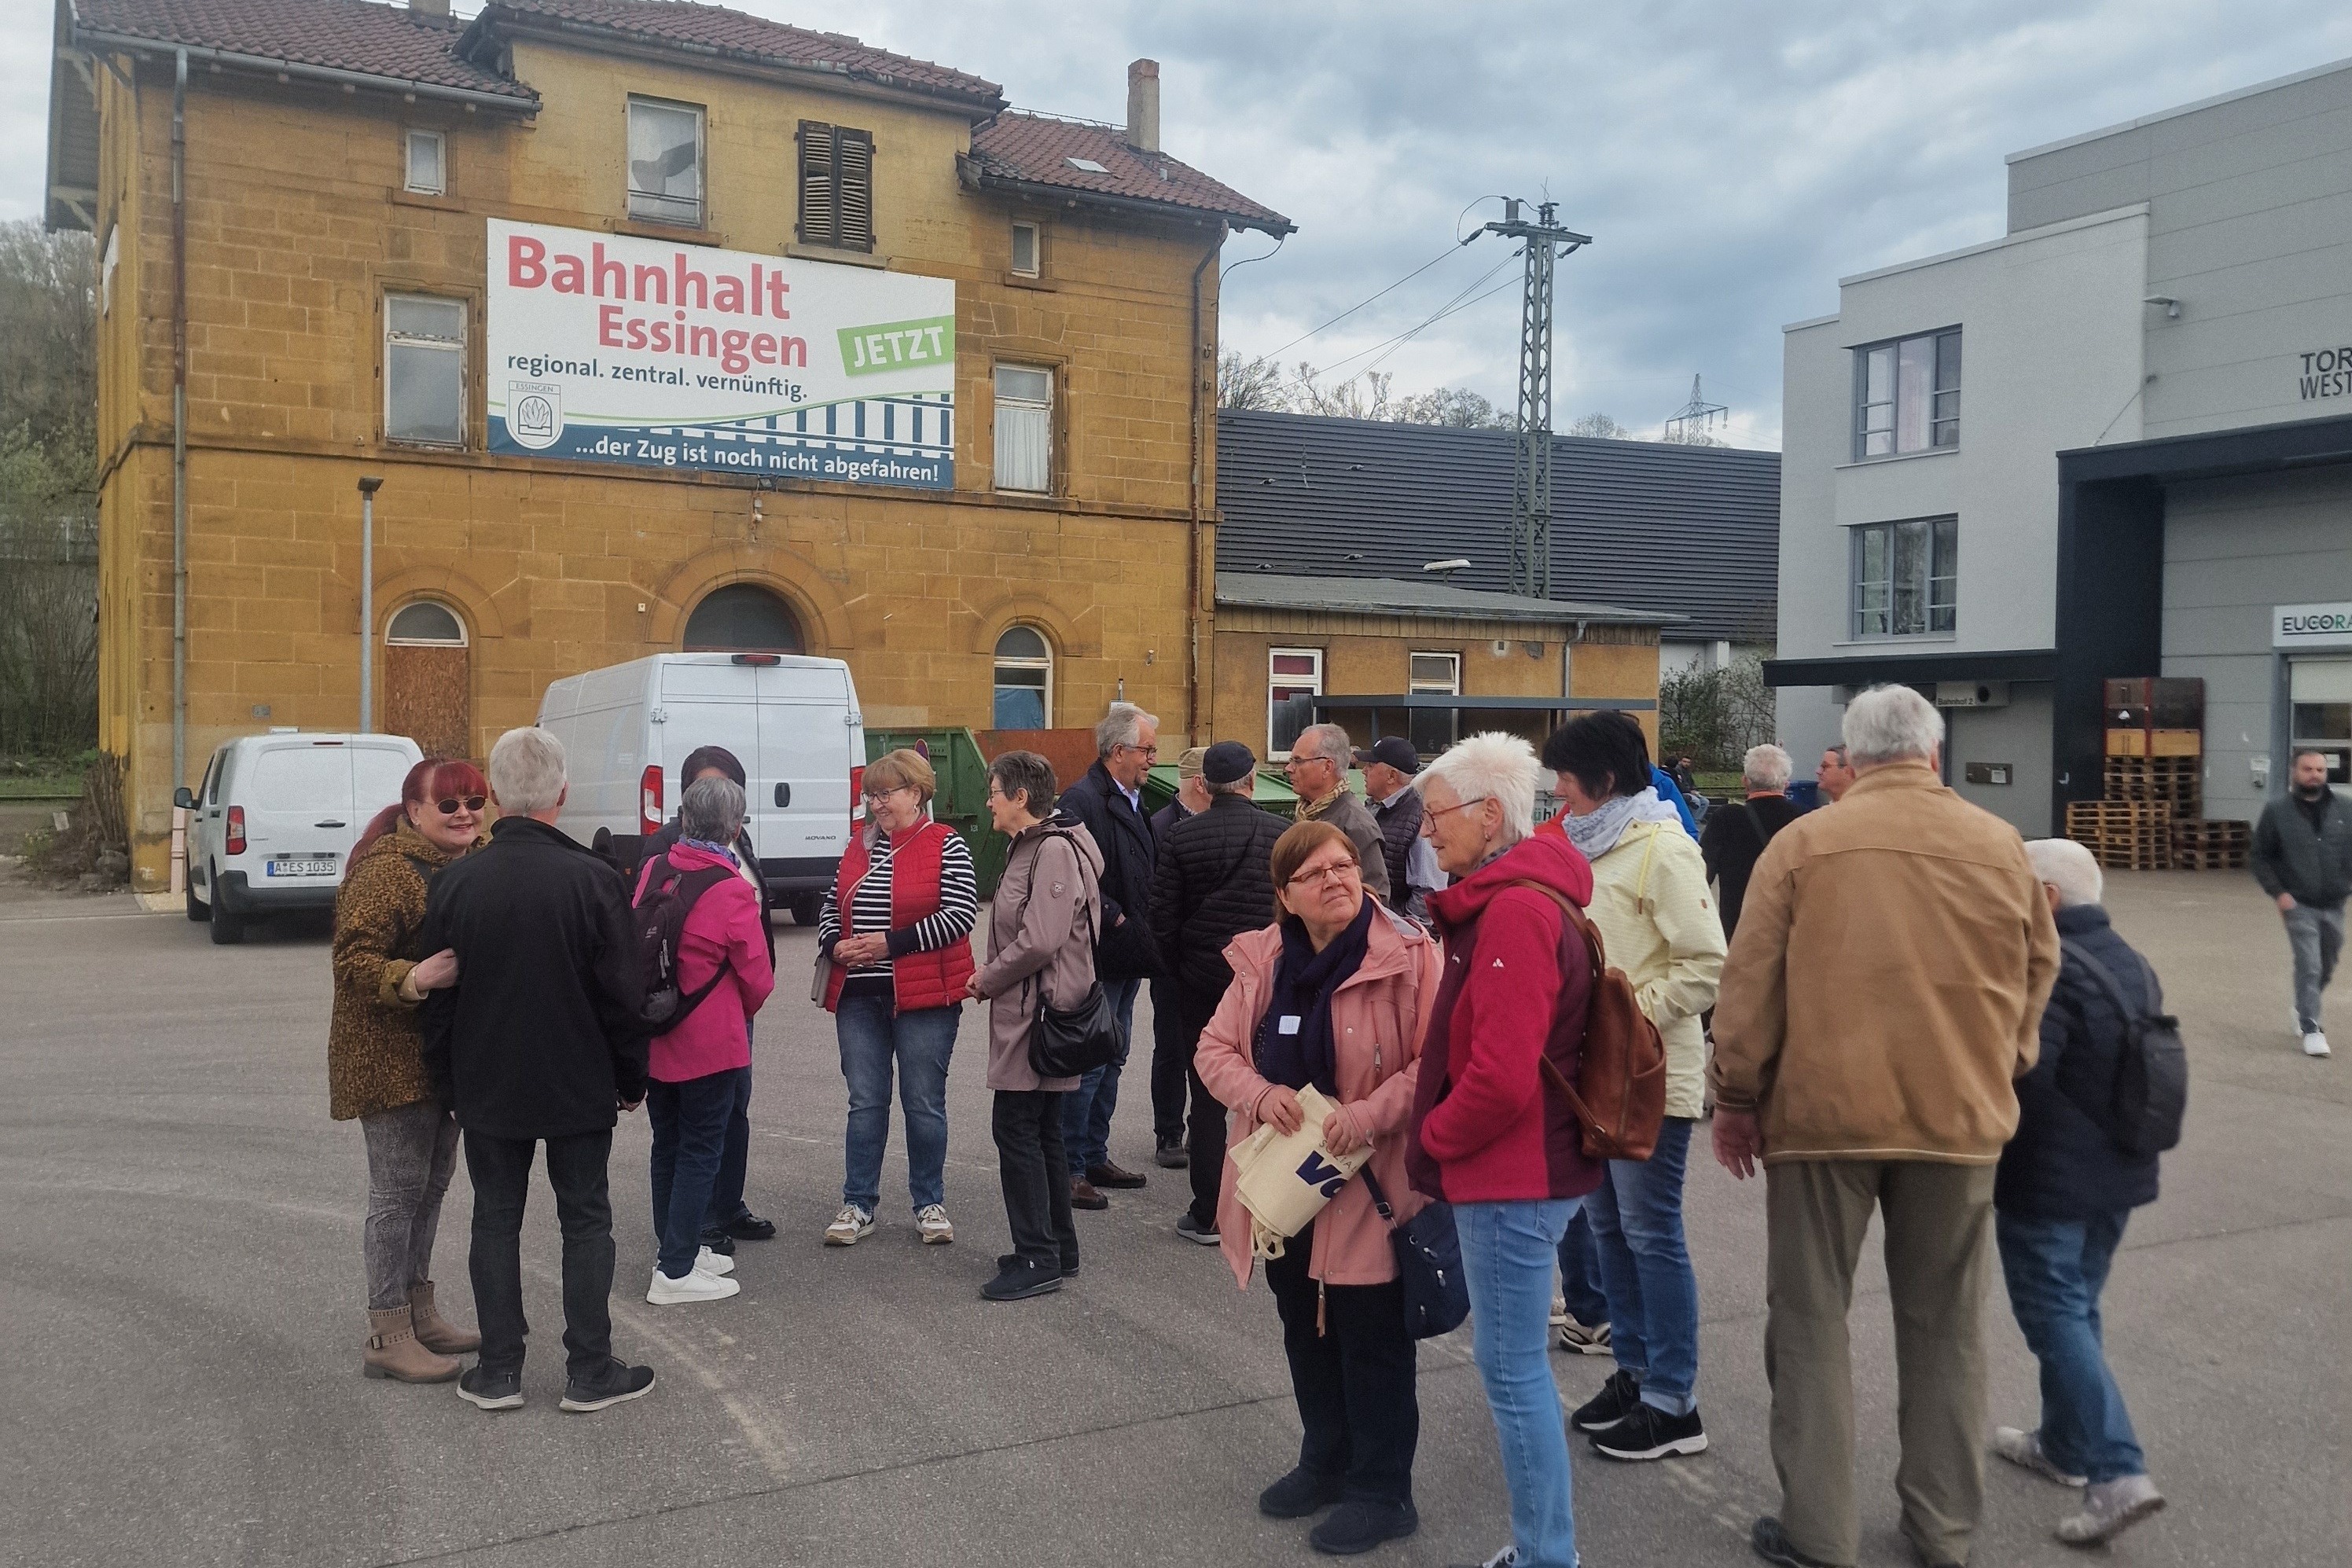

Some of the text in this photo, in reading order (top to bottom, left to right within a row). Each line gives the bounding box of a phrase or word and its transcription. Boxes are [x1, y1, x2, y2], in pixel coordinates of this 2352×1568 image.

[508, 234, 790, 320] Bahnhalt
[599, 304, 807, 374] Essingen
[854, 325, 943, 368] JETZT
[508, 354, 807, 402] regional. zentral. vernünftig.
[516, 383, 553, 392] ESSINGEN
[637, 439, 677, 466] Zug
[683, 442, 707, 463] ist
[714, 448, 763, 467] noch
[769, 450, 818, 472] nicht
[824, 455, 939, 482] abgefahren!
[275, 861, 333, 872] A ES 1035
